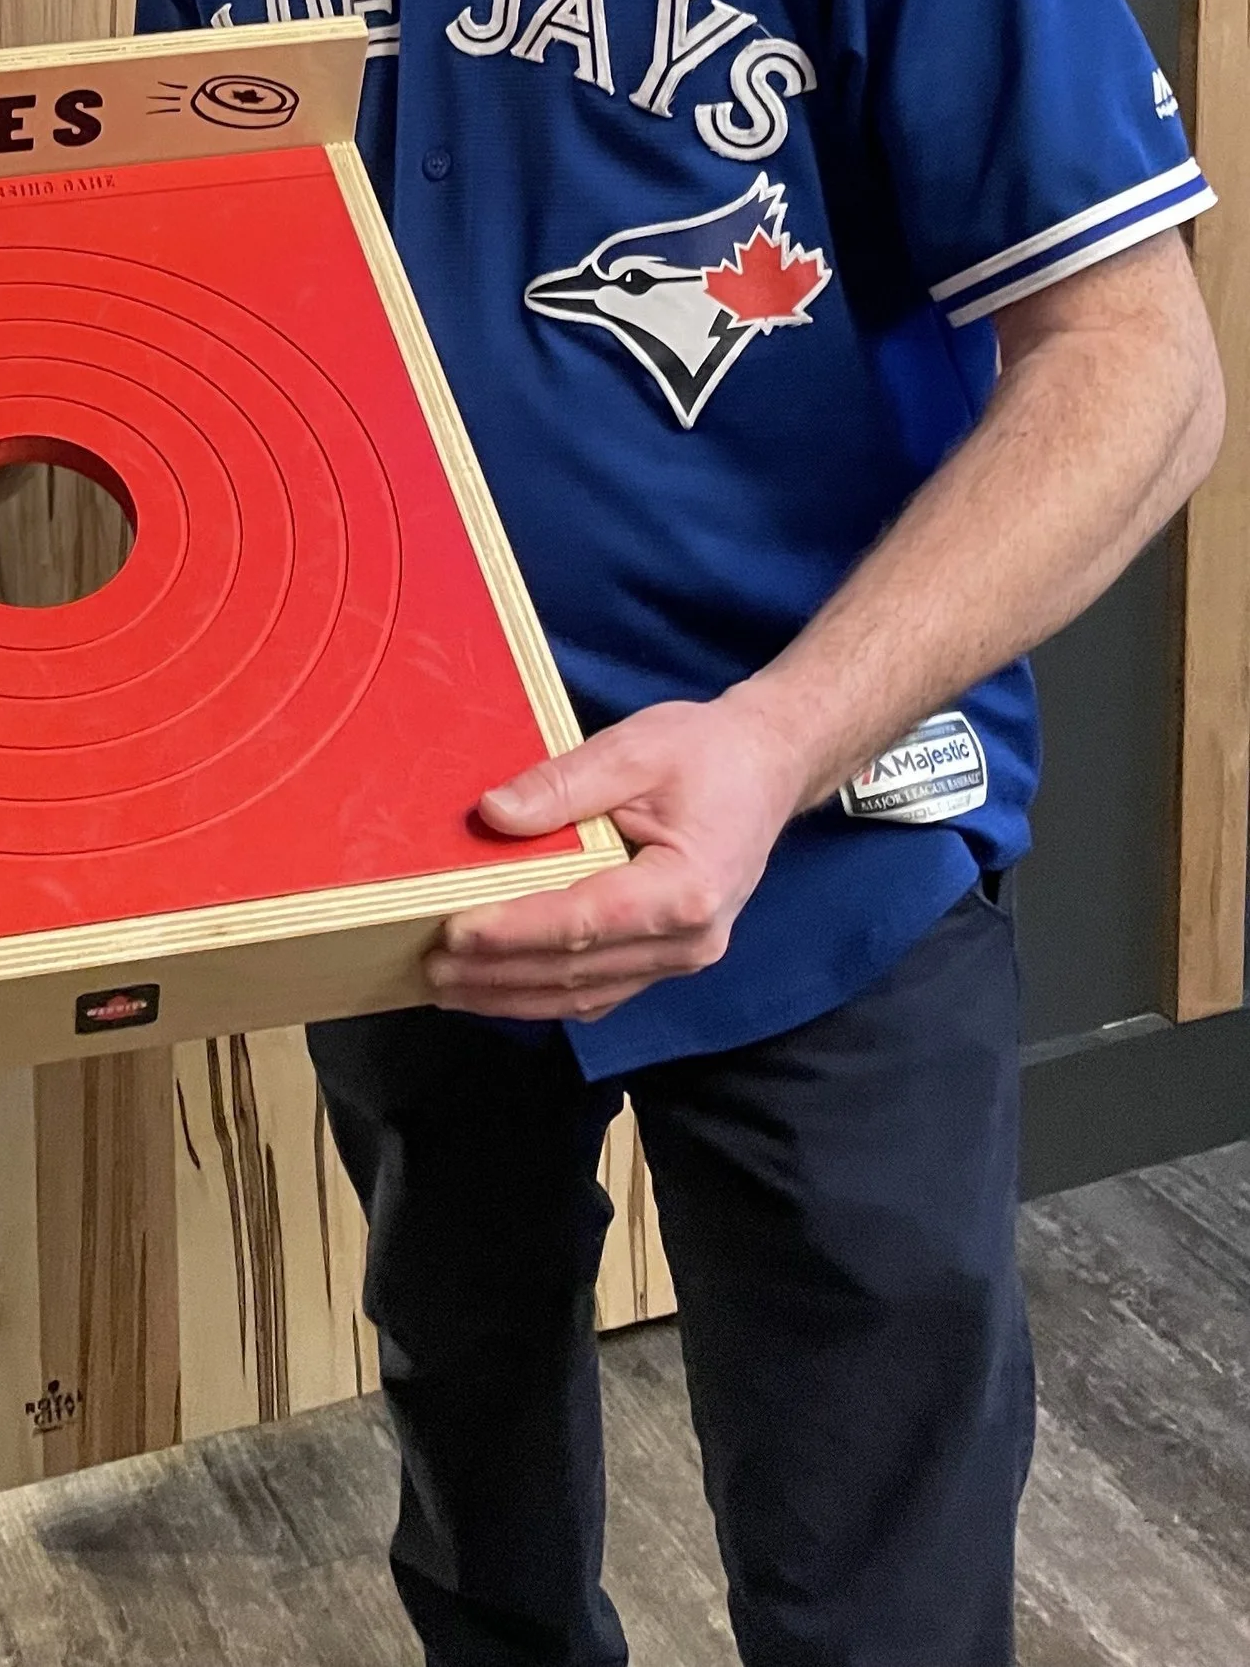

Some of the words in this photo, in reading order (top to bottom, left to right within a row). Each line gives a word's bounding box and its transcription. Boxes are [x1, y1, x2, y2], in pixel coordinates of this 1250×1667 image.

[63, 173, 117, 193] GAME
[892, 738, 970, 776] Majestic
[861, 793, 905, 812] MAJOR
[904, 782, 947, 805] LEAGUE
